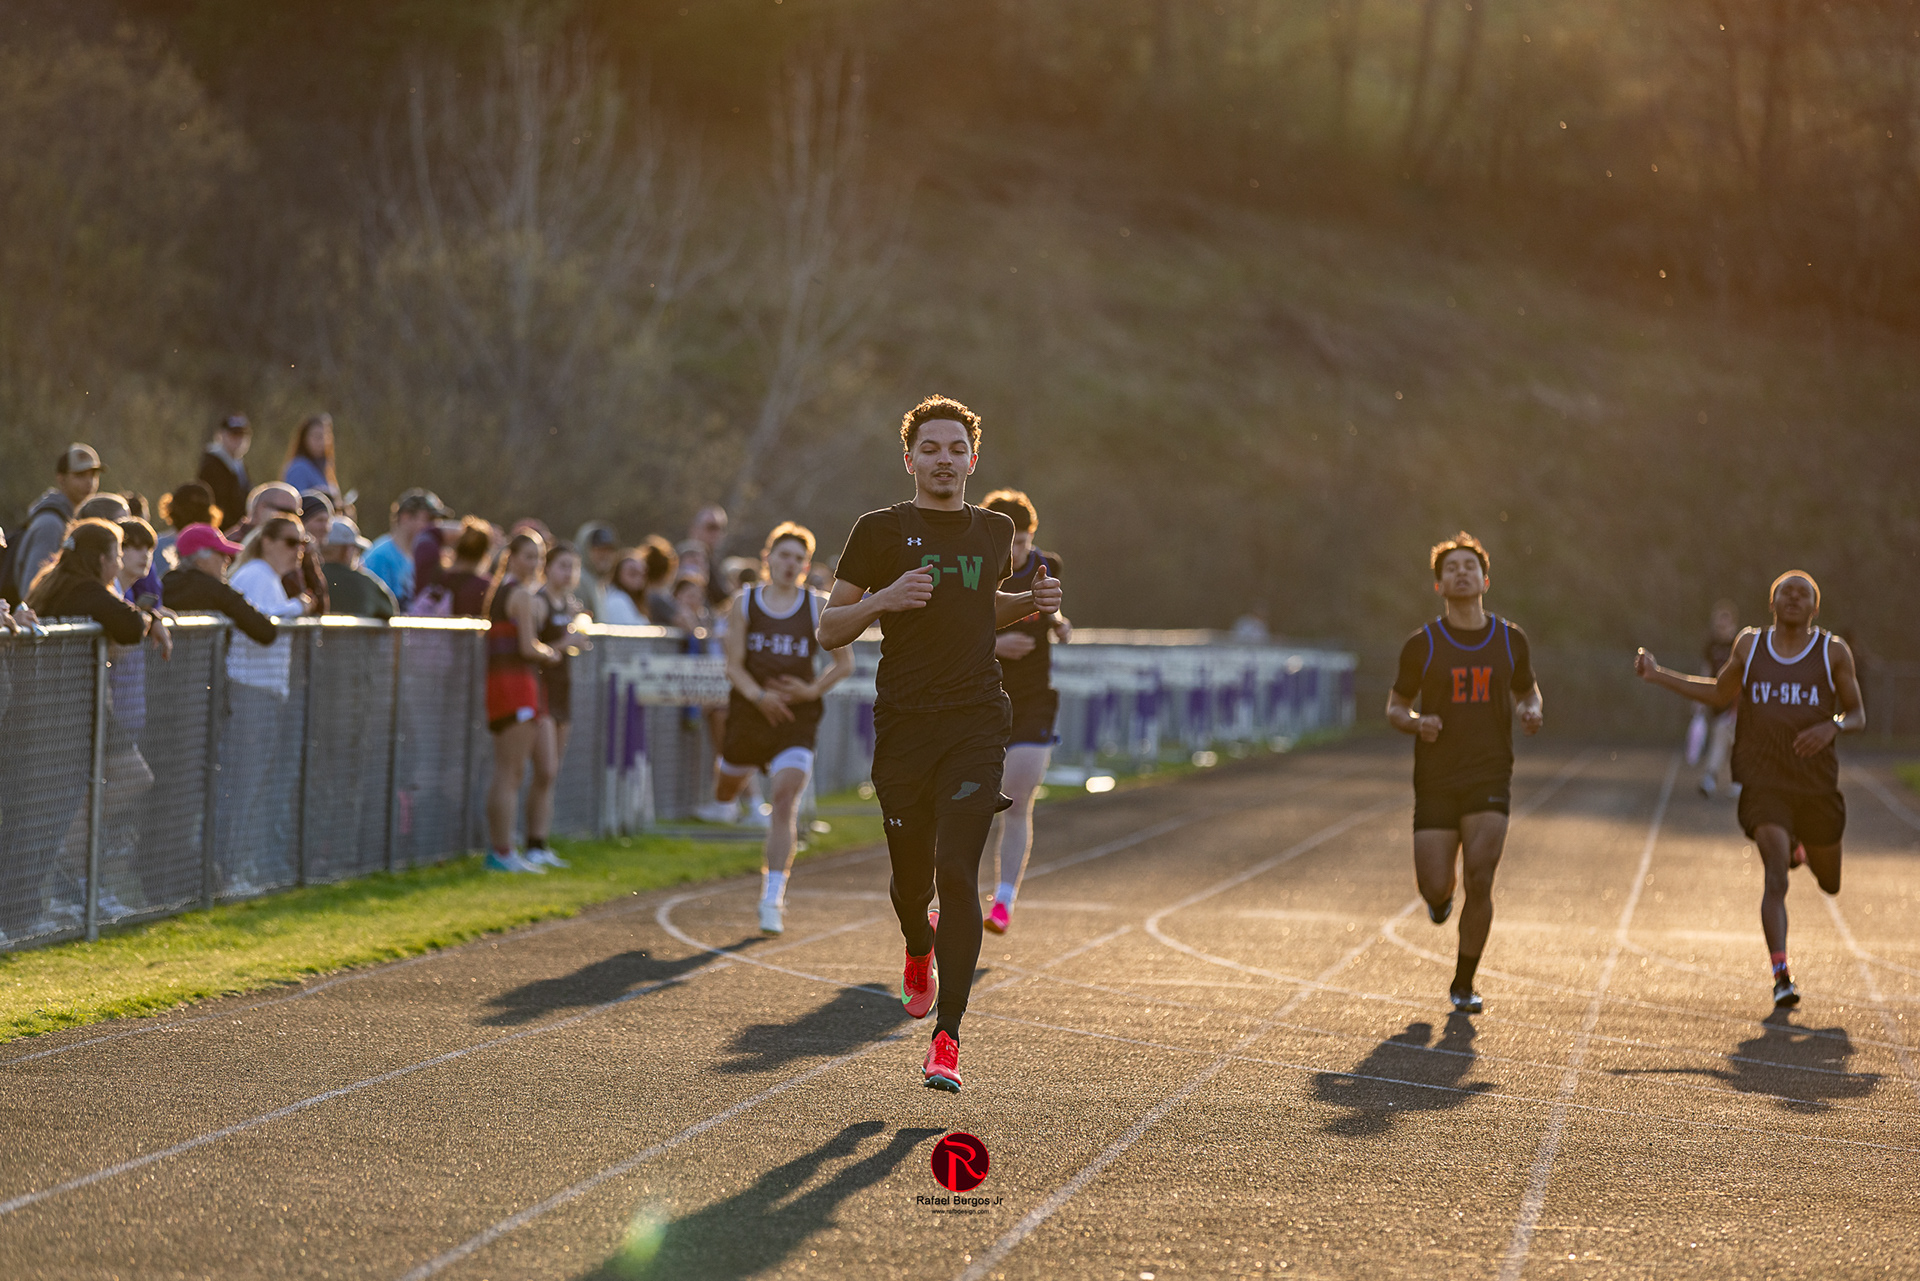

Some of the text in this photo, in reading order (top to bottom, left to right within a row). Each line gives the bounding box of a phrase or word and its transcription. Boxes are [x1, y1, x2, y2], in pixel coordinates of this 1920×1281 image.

[921, 554, 983, 591] S-W
[1451, 667, 1493, 703] EM
[1752, 681, 1819, 706] CV-SK-A
